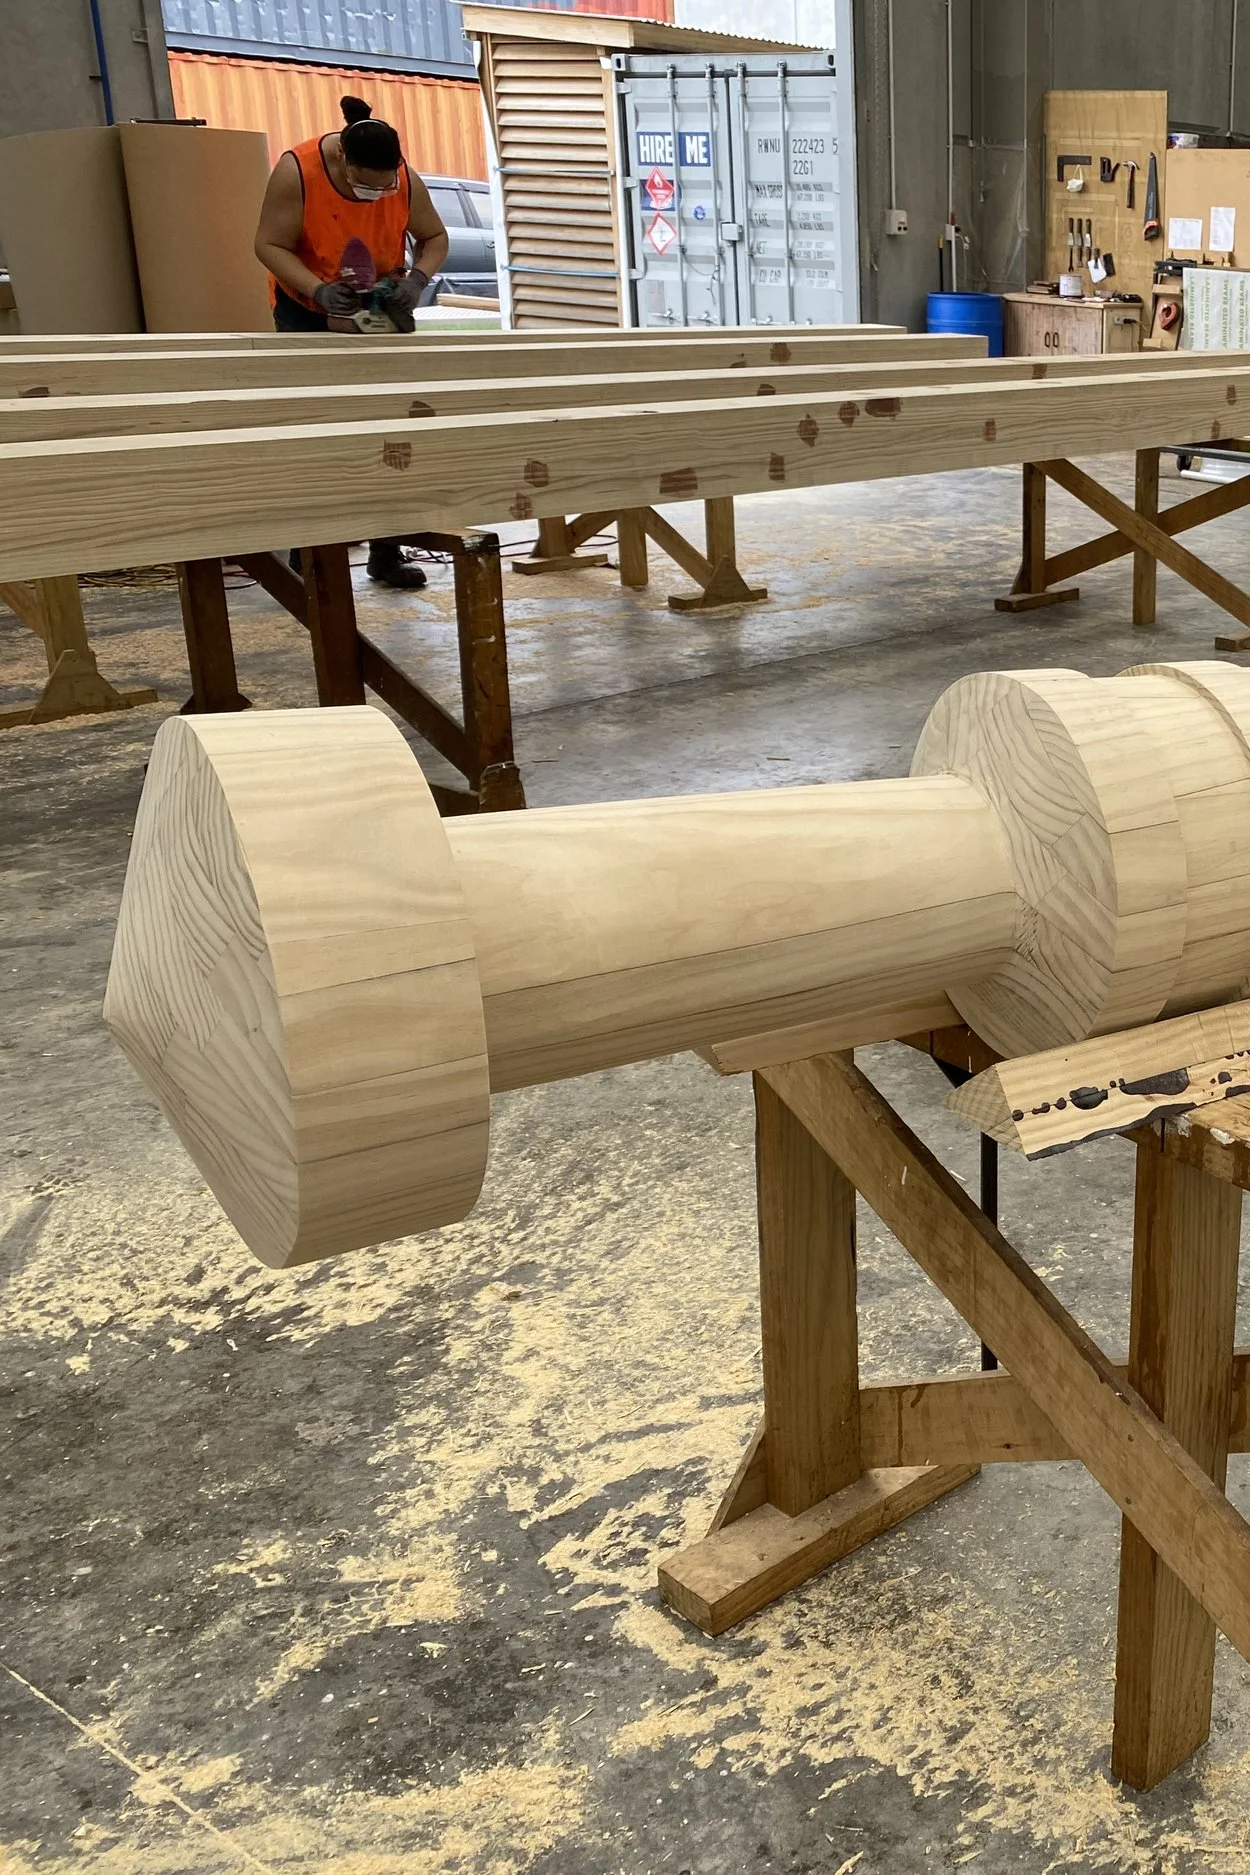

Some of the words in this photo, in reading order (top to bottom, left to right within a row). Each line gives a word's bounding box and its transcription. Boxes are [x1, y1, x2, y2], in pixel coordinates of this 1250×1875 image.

[640, 135, 674, 163] HIRE
[685, 135, 708, 164] ME
[757, 138, 781, 153] RWNU
[792, 138, 825, 154] 222423
[832, 138, 839, 155] 5
[792, 160, 814, 175] 22G1
